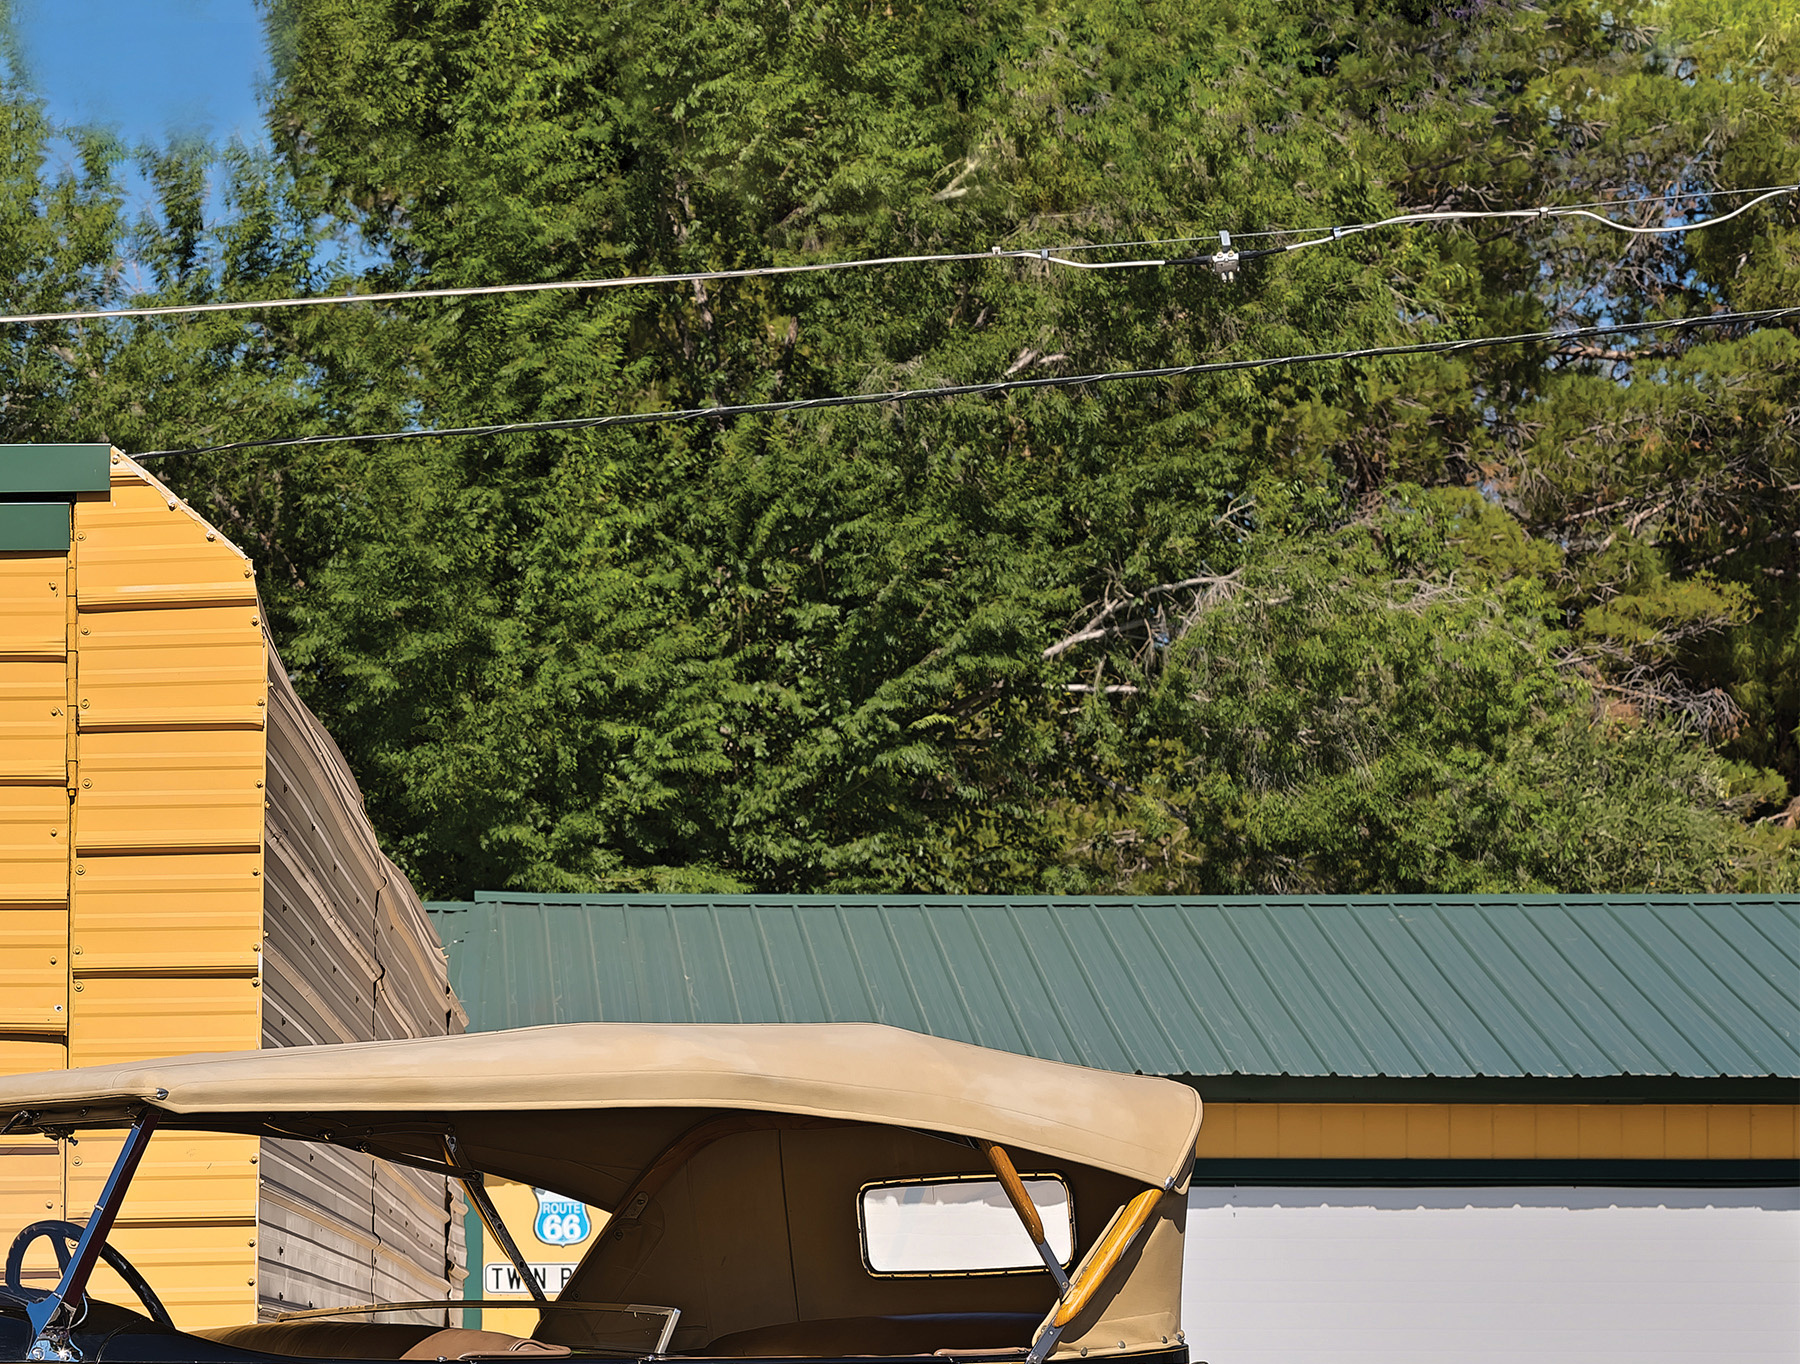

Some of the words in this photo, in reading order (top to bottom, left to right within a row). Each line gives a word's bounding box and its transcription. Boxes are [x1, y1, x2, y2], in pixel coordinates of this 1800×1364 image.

[542, 1202, 581, 1214] ROUTE
[543, 1214, 582, 1241] 66
[491, 1267, 546, 1290] TWN
